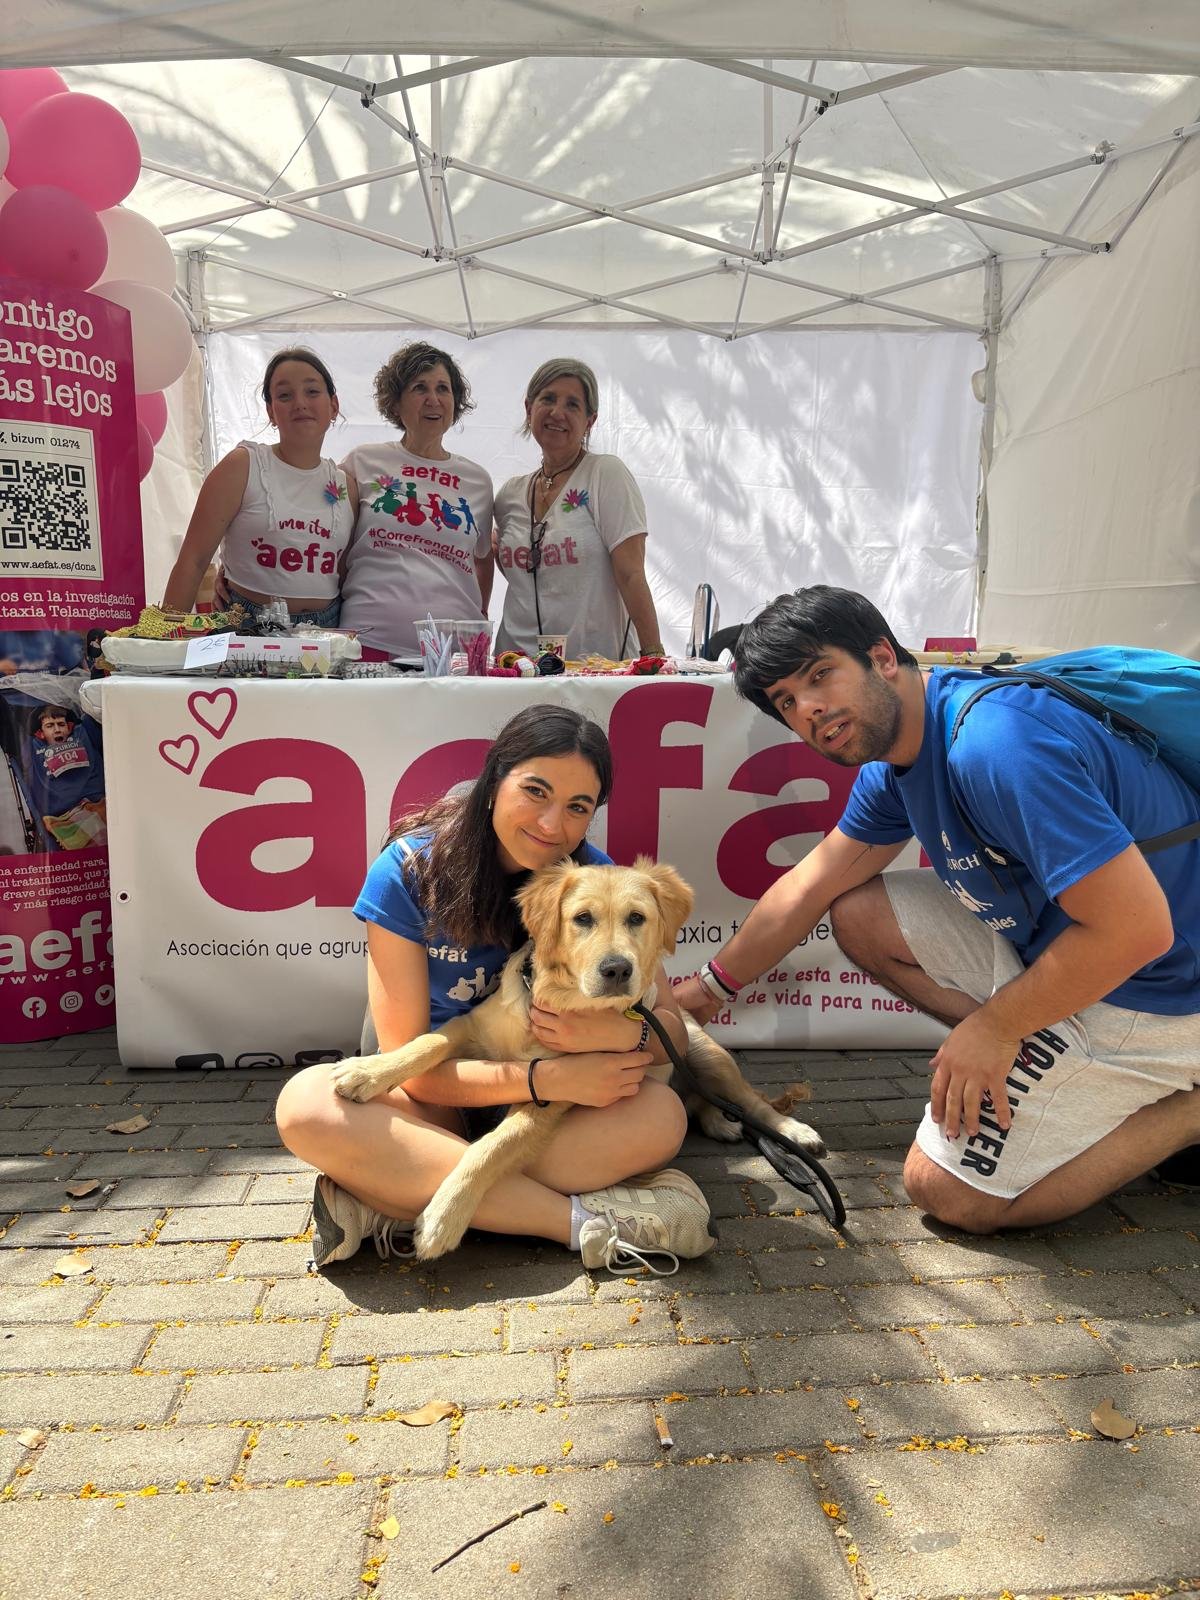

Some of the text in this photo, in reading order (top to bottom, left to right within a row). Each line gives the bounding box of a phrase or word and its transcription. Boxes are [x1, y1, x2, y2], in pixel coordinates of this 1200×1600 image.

[0, 299, 94, 342] ntigo
[41, 375, 113, 417] lejos
[10, 432, 81, 450] bizum 01274
[401, 465, 461, 491] aefat
[1, 561, 97, 572] www.aefat.es/dona
[256, 542, 343, 575] aefa
[23, 592, 43, 603] en
[47, 590, 62, 602] la
[65, 590, 136, 606] investigación
[0, 605, 132, 620] taxia Telangiectasia
[58, 750, 79, 763] 104
[14, 860, 81, 875] enfermedad
[11, 873, 82, 888] tratamiento,
[84, 870, 101, 881] que
[3, 889, 36, 901] grave
[38, 879, 105, 897] discapacidad
[13, 902, 22, 912] y
[23, 899, 48, 909] más
[50, 895, 83, 906] riesgo
[85, 892, 97, 901] de
[0, 910, 114, 975] aef
[166, 938, 269, 957] Asociación
[276, 942, 312, 960] que
[768, 968, 788, 983] de
[795, 966, 831, 983] esta
[746, 990, 766, 1005] de
[775, 988, 812, 1007] vida
[821, 995, 862, 1012] para
